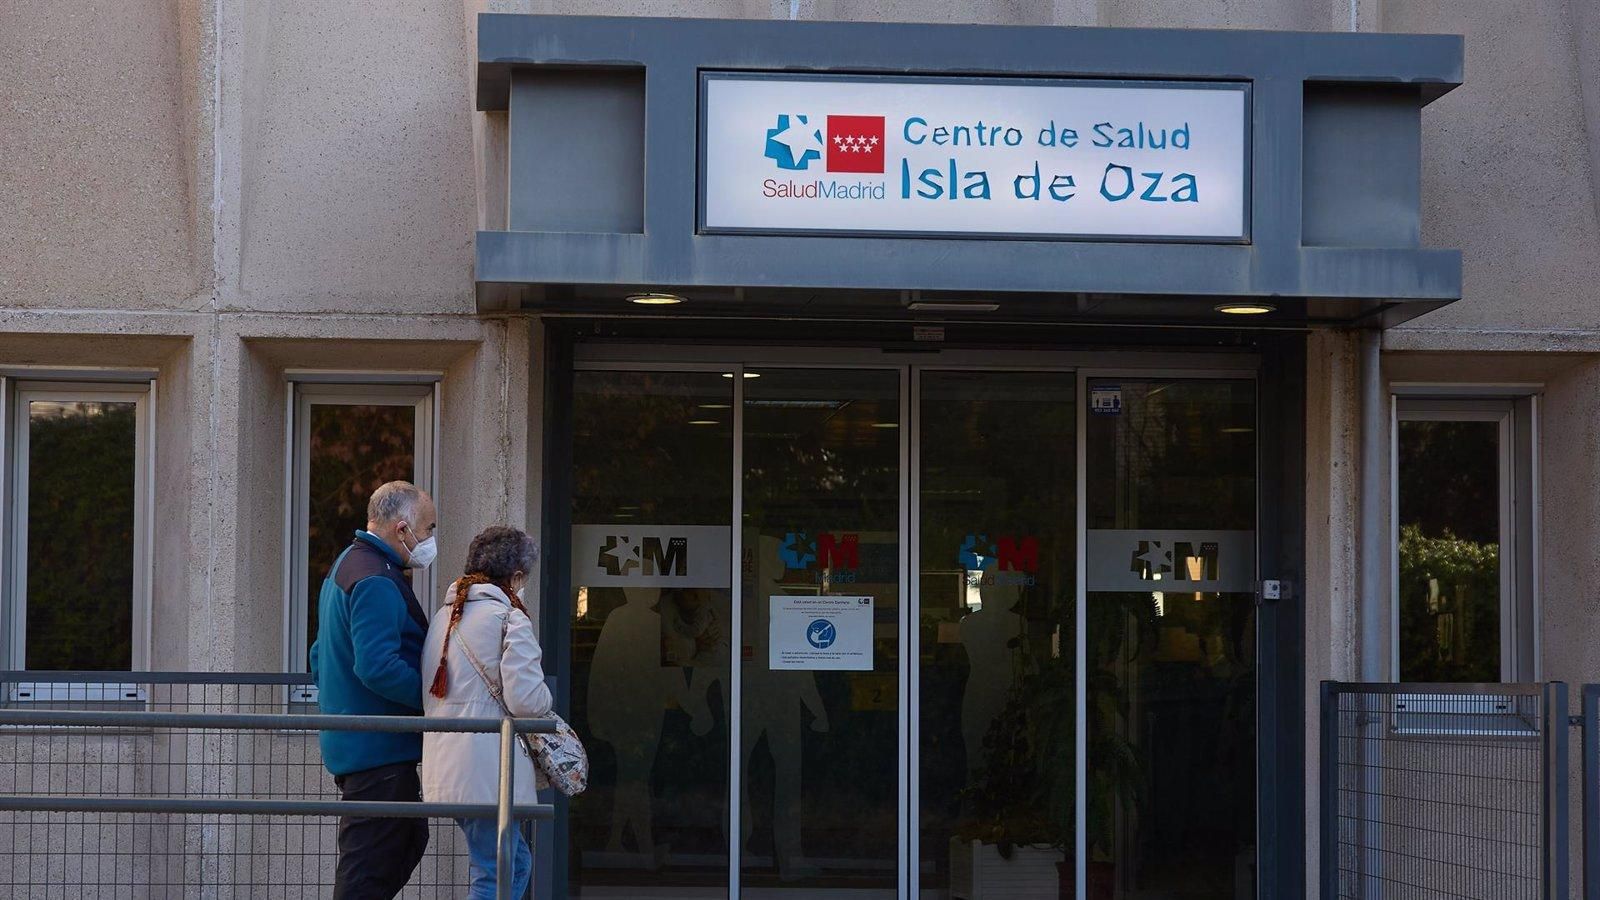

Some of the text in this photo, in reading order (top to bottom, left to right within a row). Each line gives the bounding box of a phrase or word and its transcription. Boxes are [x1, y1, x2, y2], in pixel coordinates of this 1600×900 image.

[904, 117, 1189, 150] Centro de Salud
[763, 179, 884, 199] SaludMadrid
[902, 158, 1199, 202] Isla de Oza
[642, 537, 687, 576] M
[818, 535, 858, 569] M
[998, 537, 1039, 571] M
[1175, 542, 1218, 580] M
